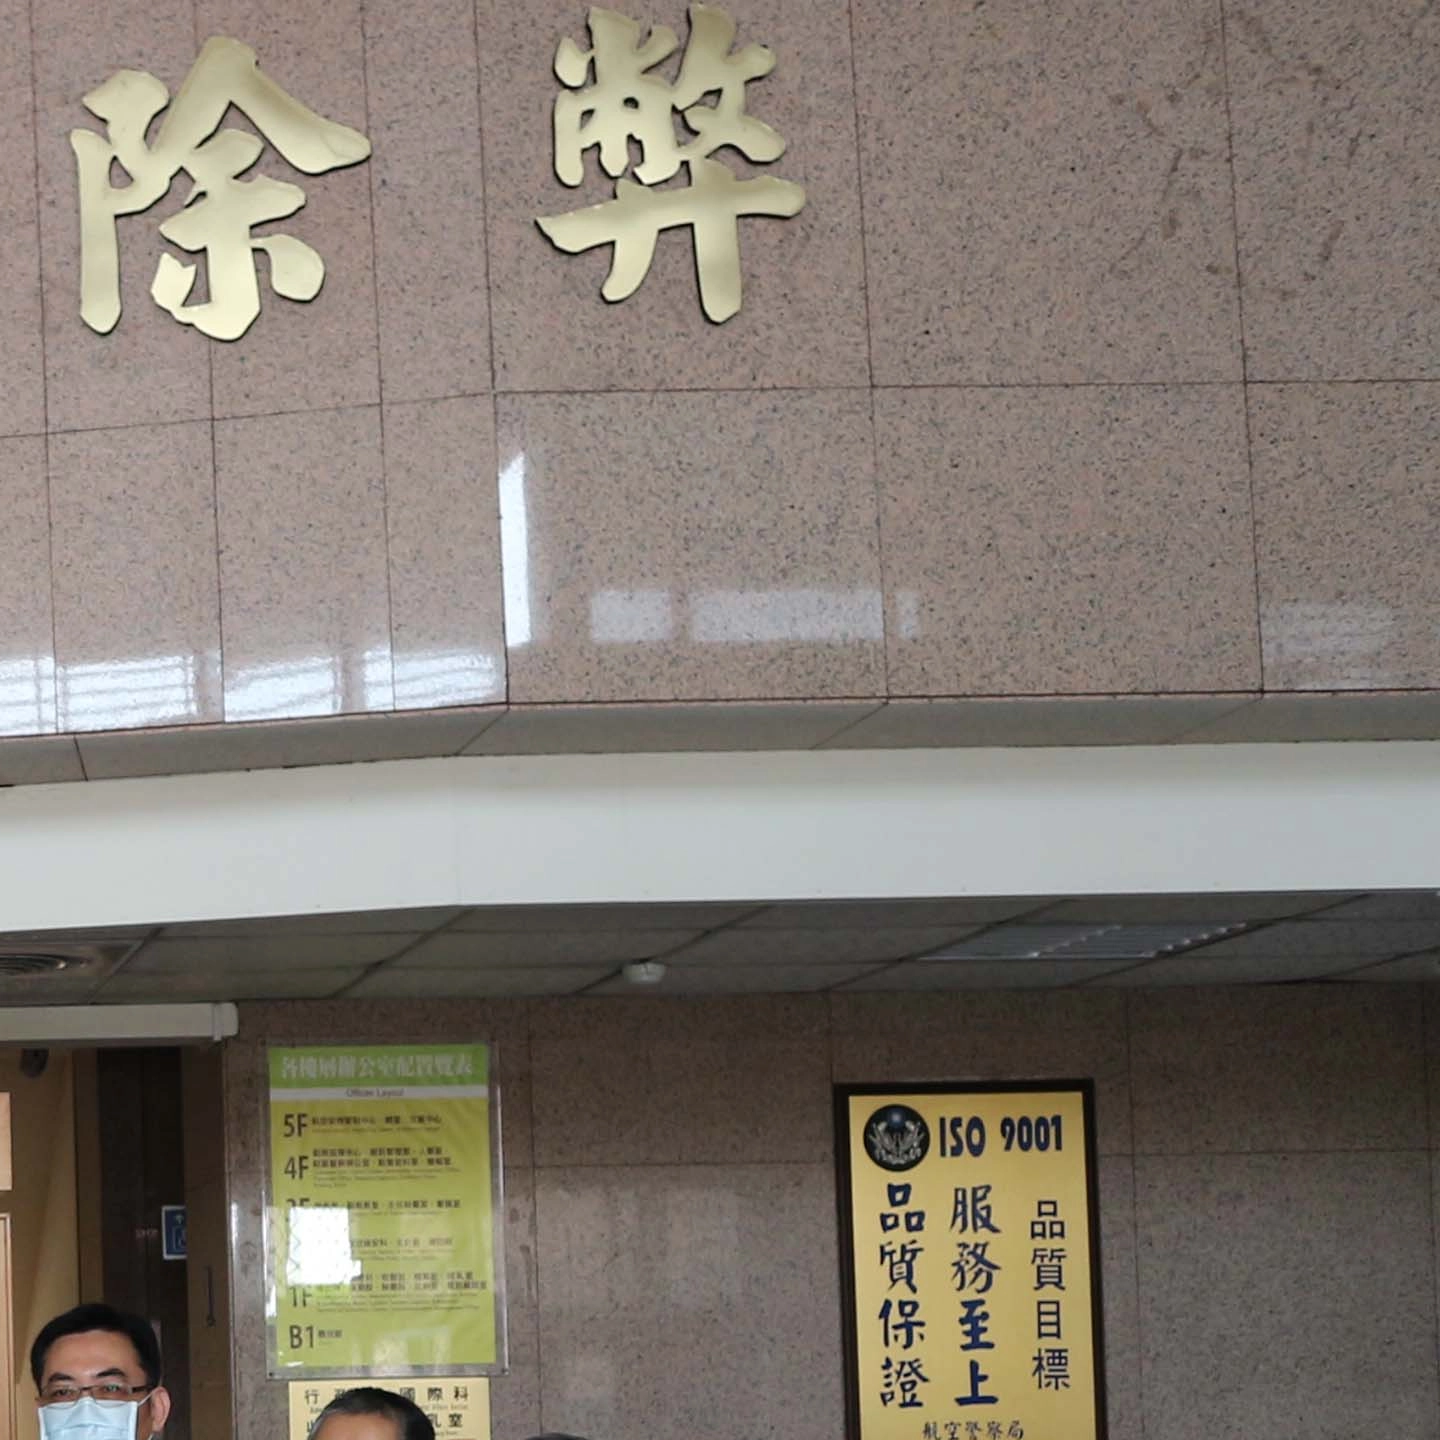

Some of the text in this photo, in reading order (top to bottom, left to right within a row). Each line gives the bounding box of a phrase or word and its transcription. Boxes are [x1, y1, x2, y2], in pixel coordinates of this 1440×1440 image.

[283, 1113, 308, 1137] 5F
[939, 1114, 1063, 1157] ISO 9001
[284, 1156, 309, 1180] 4F
[878, 1183, 929, 1409] 品質保證
[950, 1184, 1001, 1407] 服務至上
[1030, 1200, 1071, 1391] 品質目標
[289, 1325, 314, 1349] B1
[922, 1421, 1024, 1440] 航空警察局
